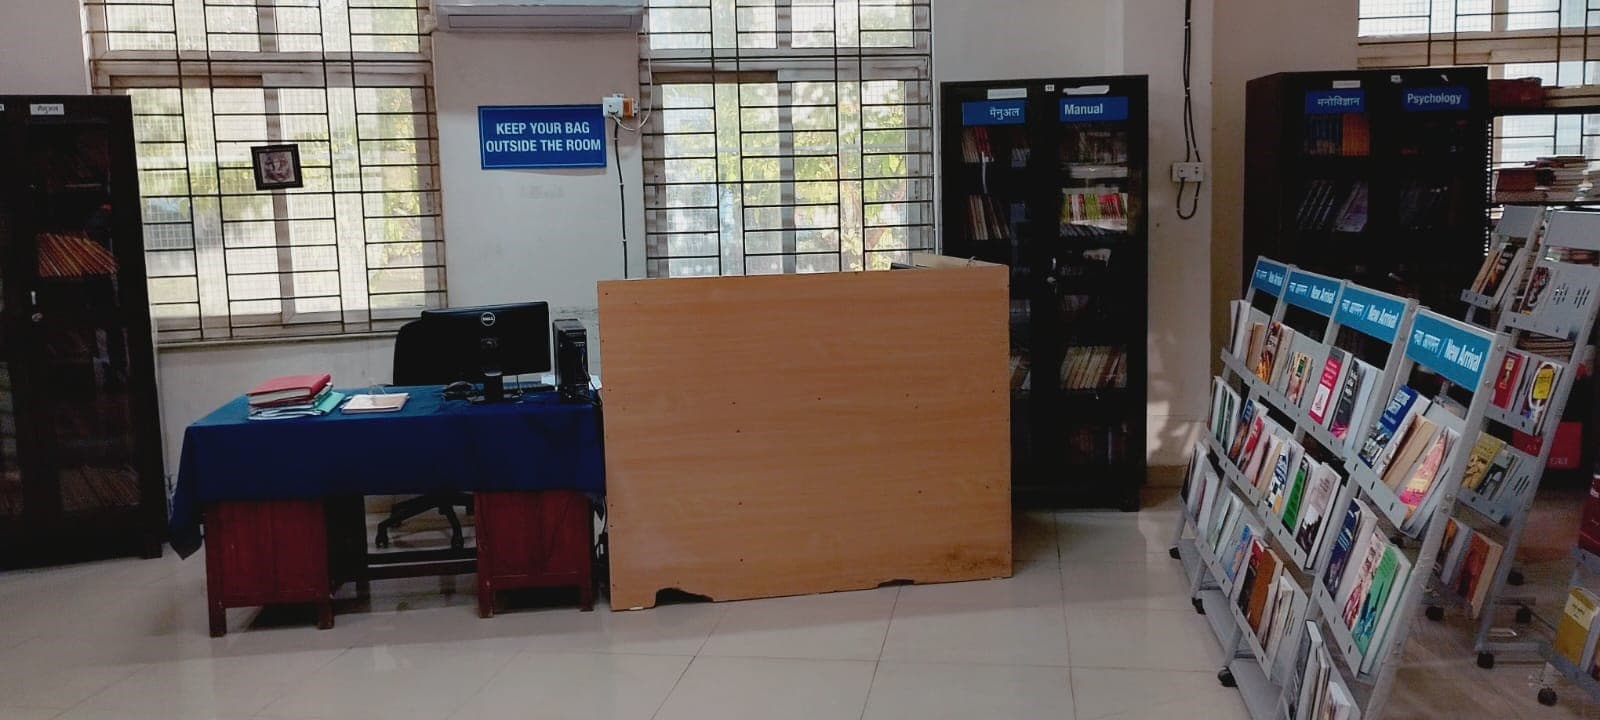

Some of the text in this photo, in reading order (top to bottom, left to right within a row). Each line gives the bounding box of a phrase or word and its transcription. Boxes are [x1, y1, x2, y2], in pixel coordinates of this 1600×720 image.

[1317, 95, 1361, 107] मनोविज्ञान
[1407, 93, 1462, 105] Psychology
[1064, 103, 1103, 116] Manual
[496, 121, 590, 135] KEEP YOUR BAG
[486, 139, 601, 153] OUTSIDE THE ROOM
[1367, 304, 1381, 323] New
[1378, 308, 1399, 329] Arrival
[1444, 338, 1460, 362] New
[1457, 344, 1483, 372] Arrival
